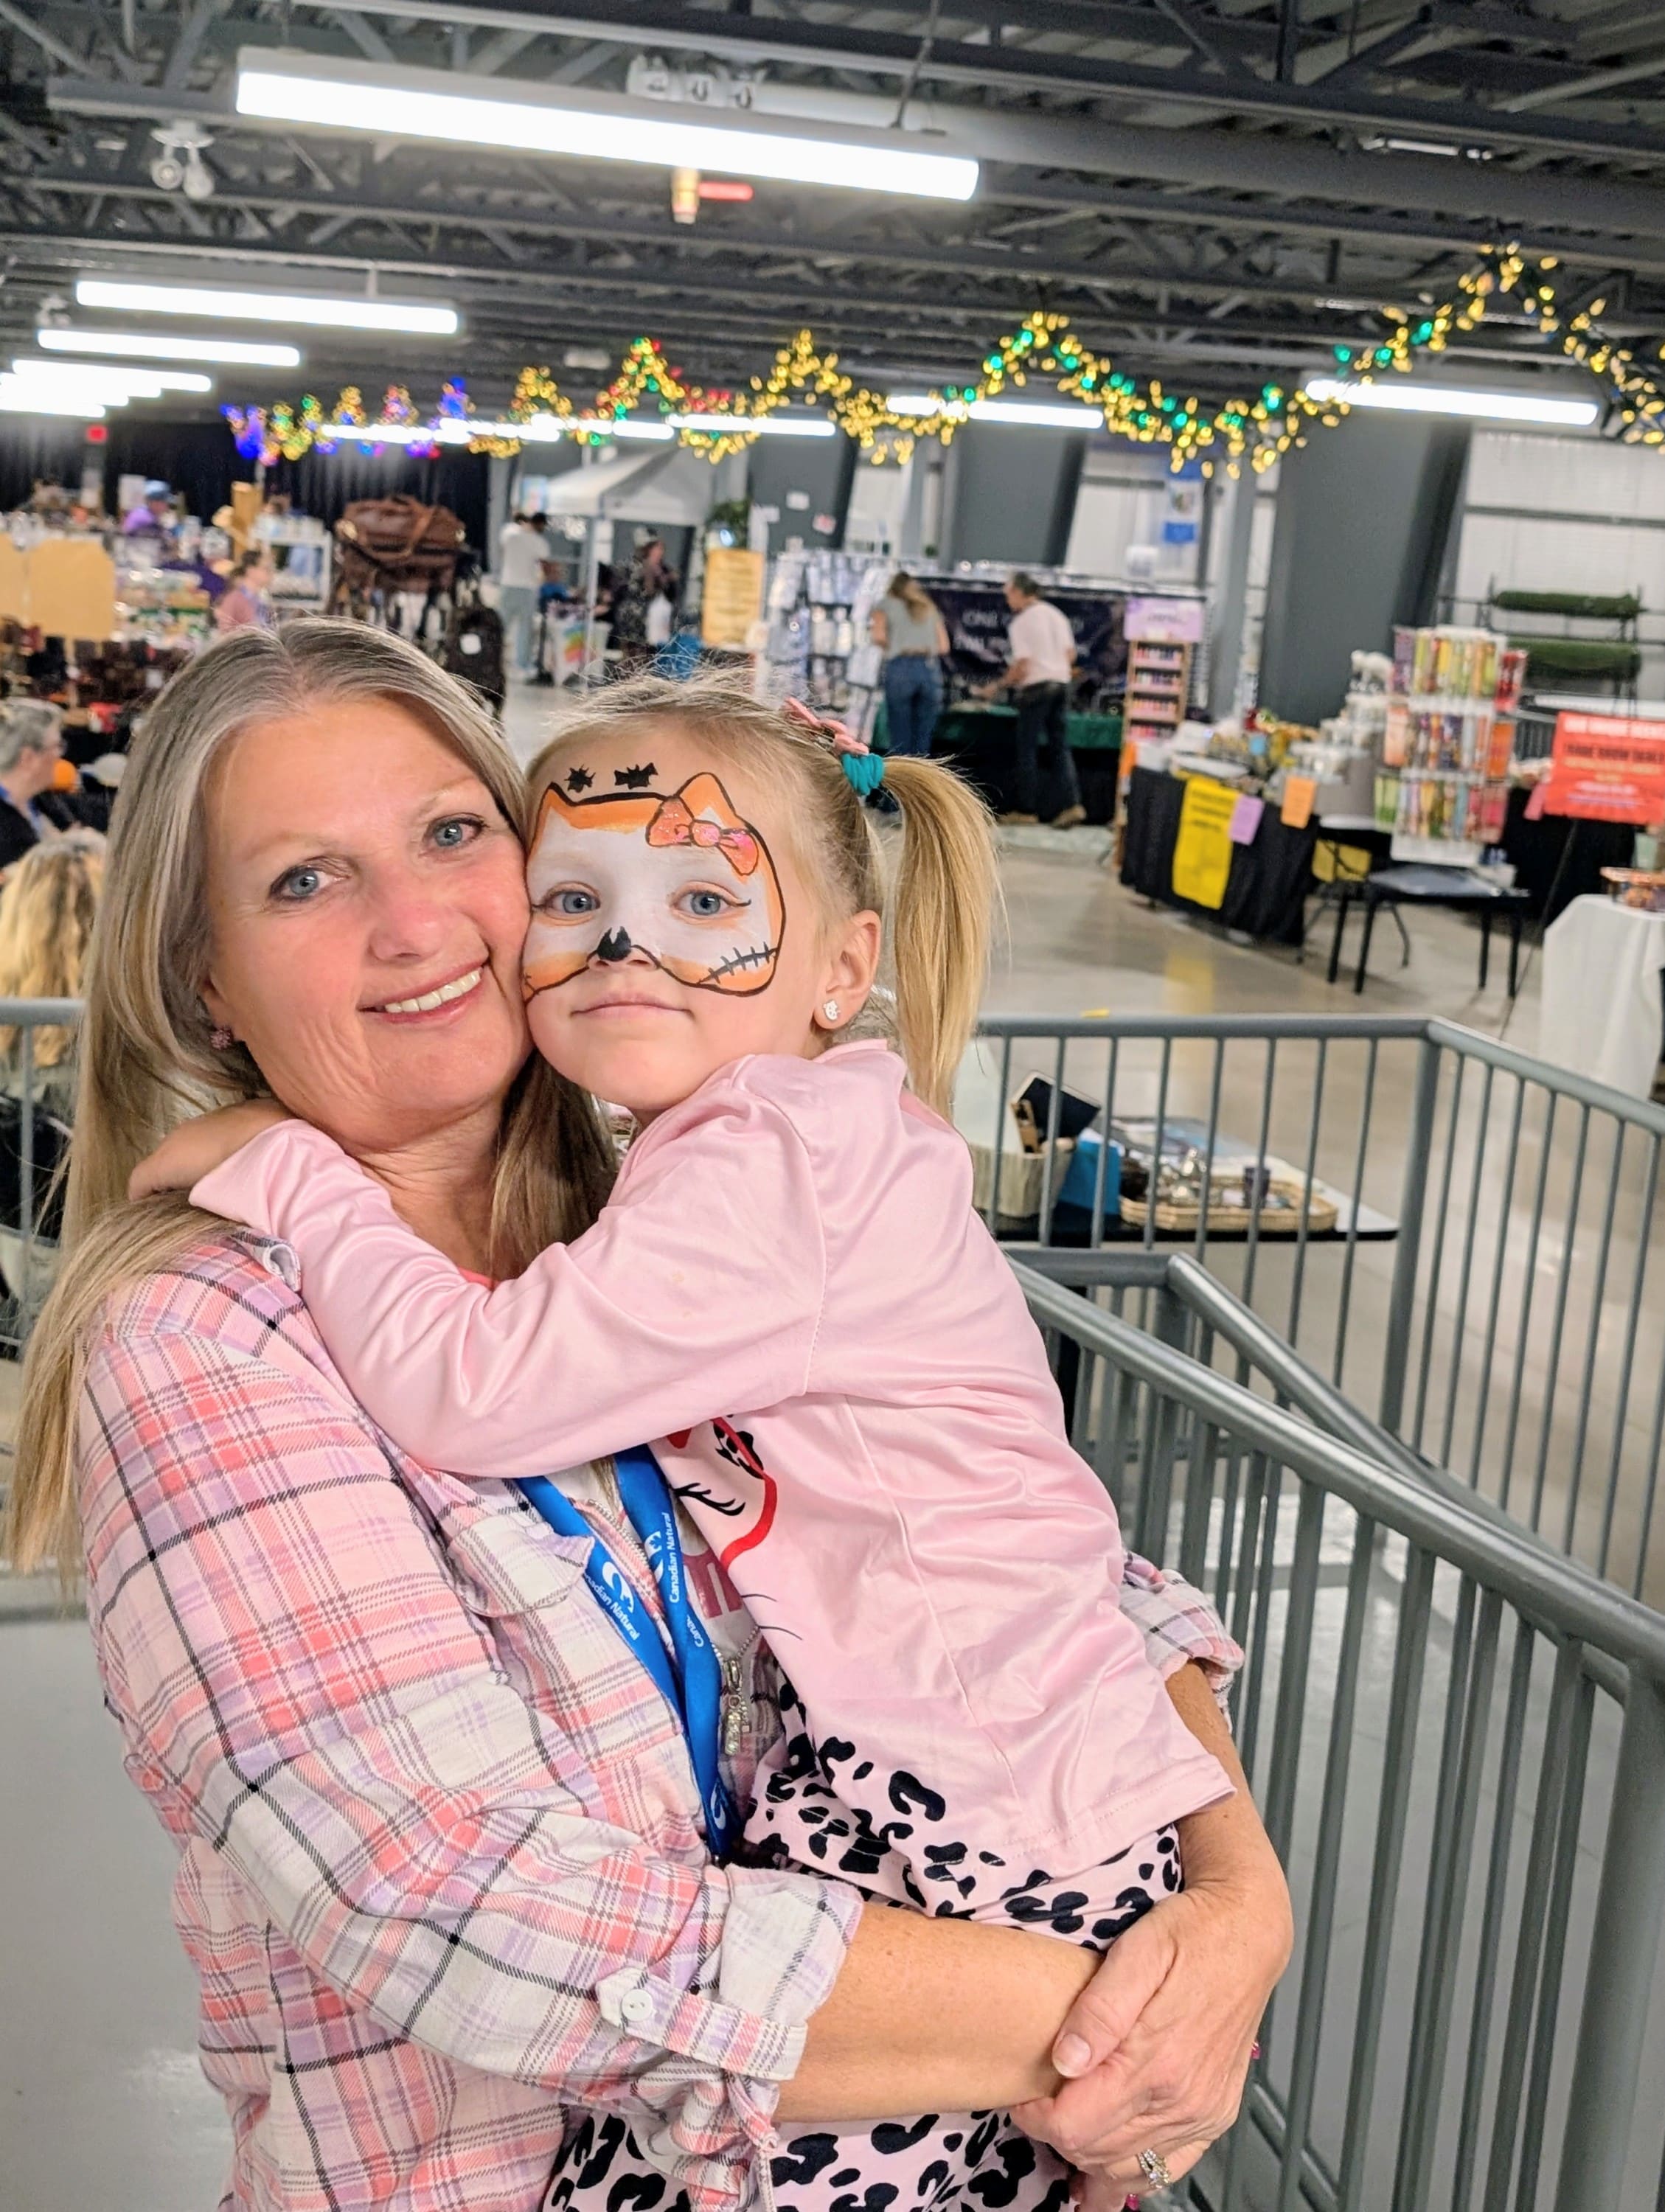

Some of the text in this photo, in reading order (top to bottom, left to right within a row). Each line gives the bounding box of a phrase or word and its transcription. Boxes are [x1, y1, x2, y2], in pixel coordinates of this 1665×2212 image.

[661, 1512, 680, 1604] Canadian Natural
[610, 1601, 641, 1641] Natural
